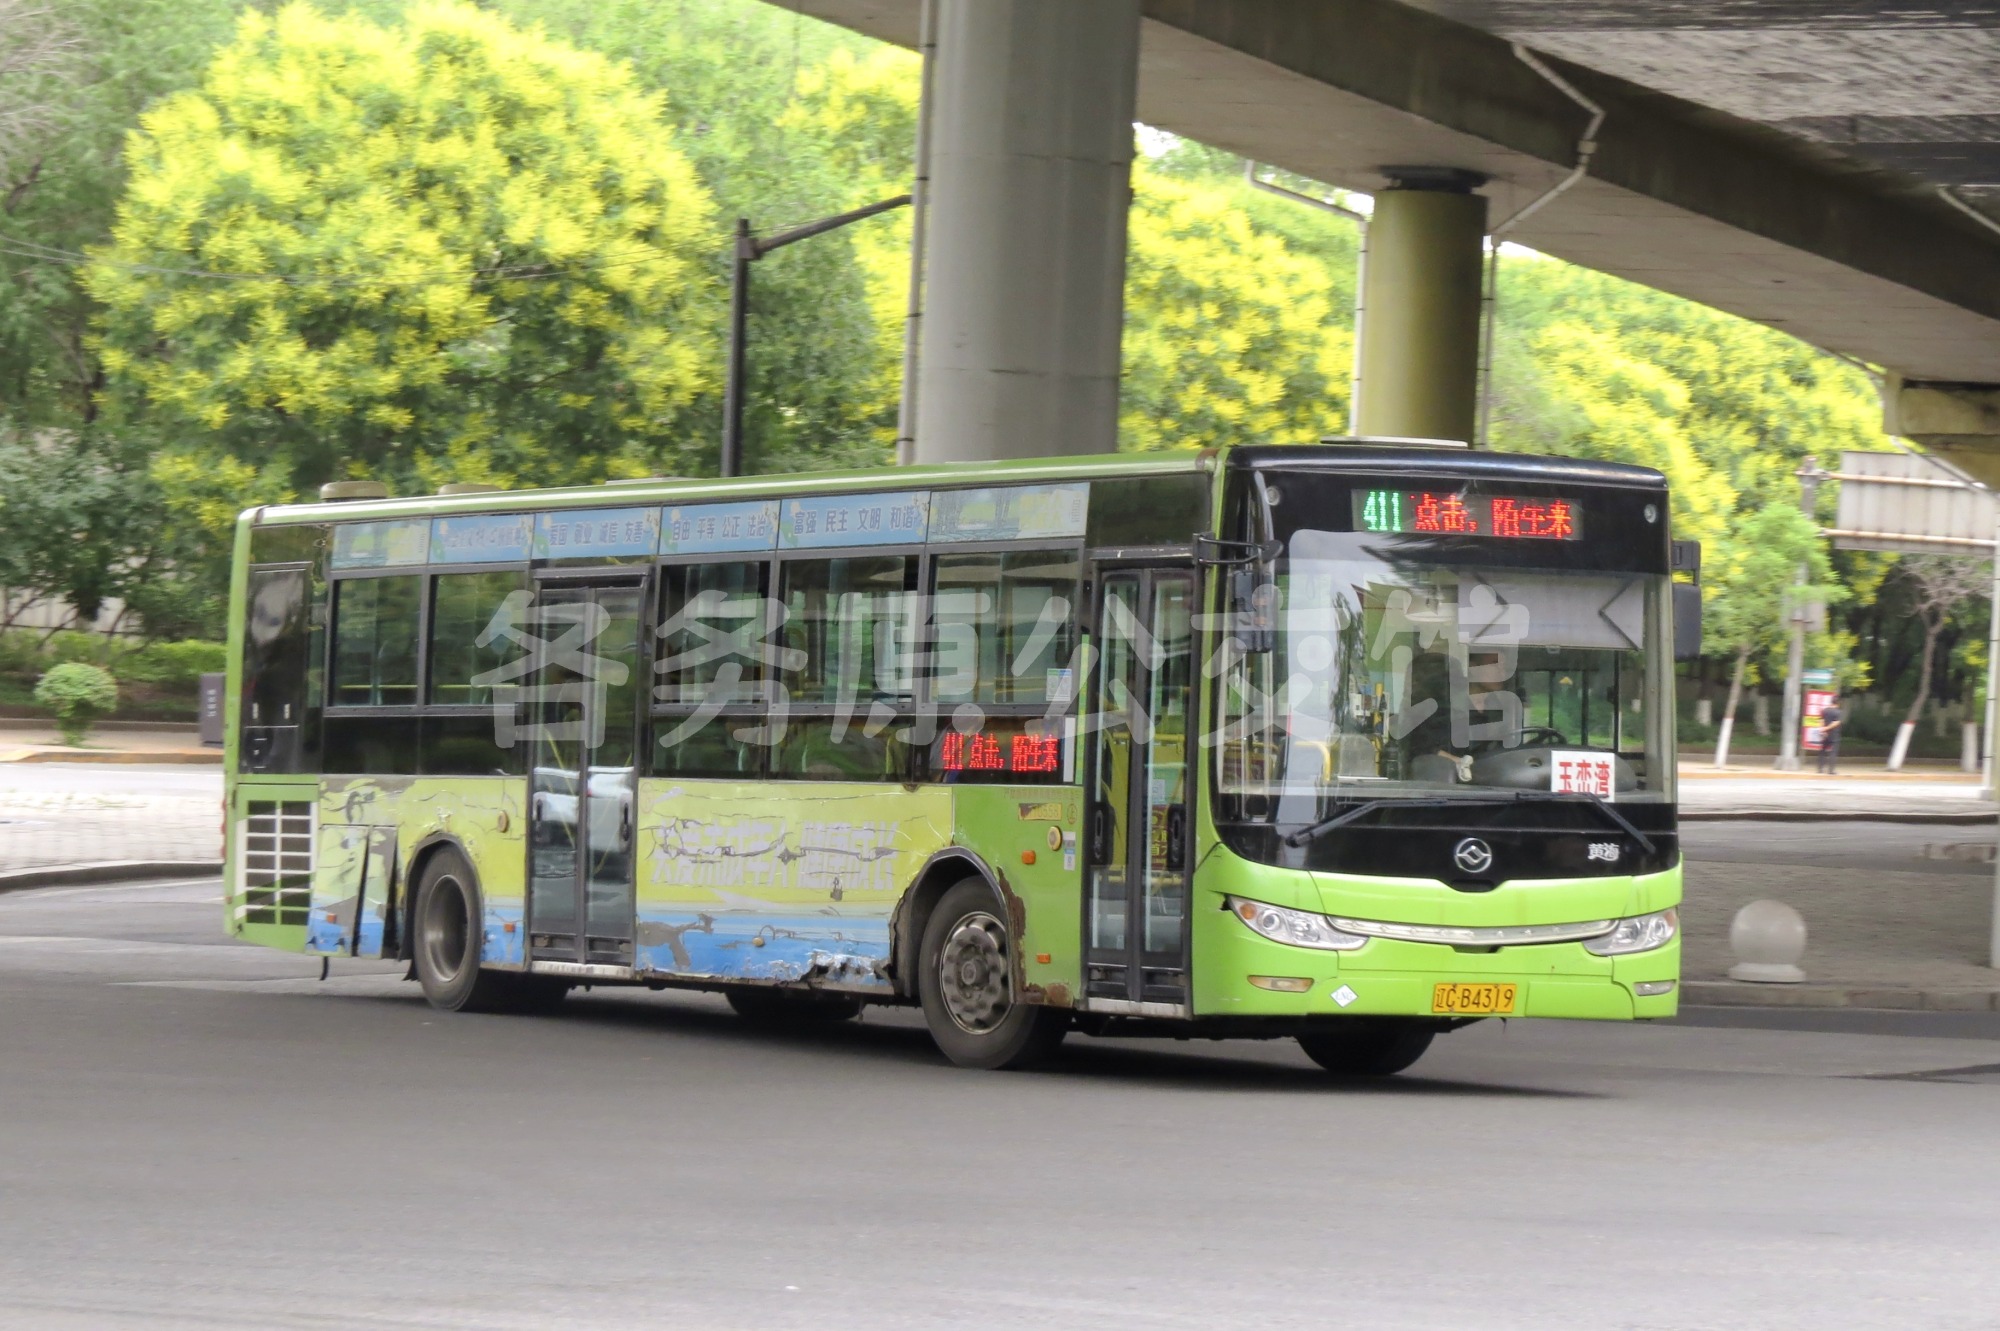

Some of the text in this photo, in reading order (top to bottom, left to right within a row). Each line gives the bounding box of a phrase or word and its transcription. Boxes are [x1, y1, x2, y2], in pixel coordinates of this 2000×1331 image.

[794, 505, 915, 535] 富强 民主 文明 和谐
[1363, 491, 1401, 532] 411
[550, 523, 568, 546] 爱国
[623, 520, 644, 543] 友善
[672, 514, 767, 541] 自由 平等 公正 法治
[1588, 842, 1620, 862] 黄海
